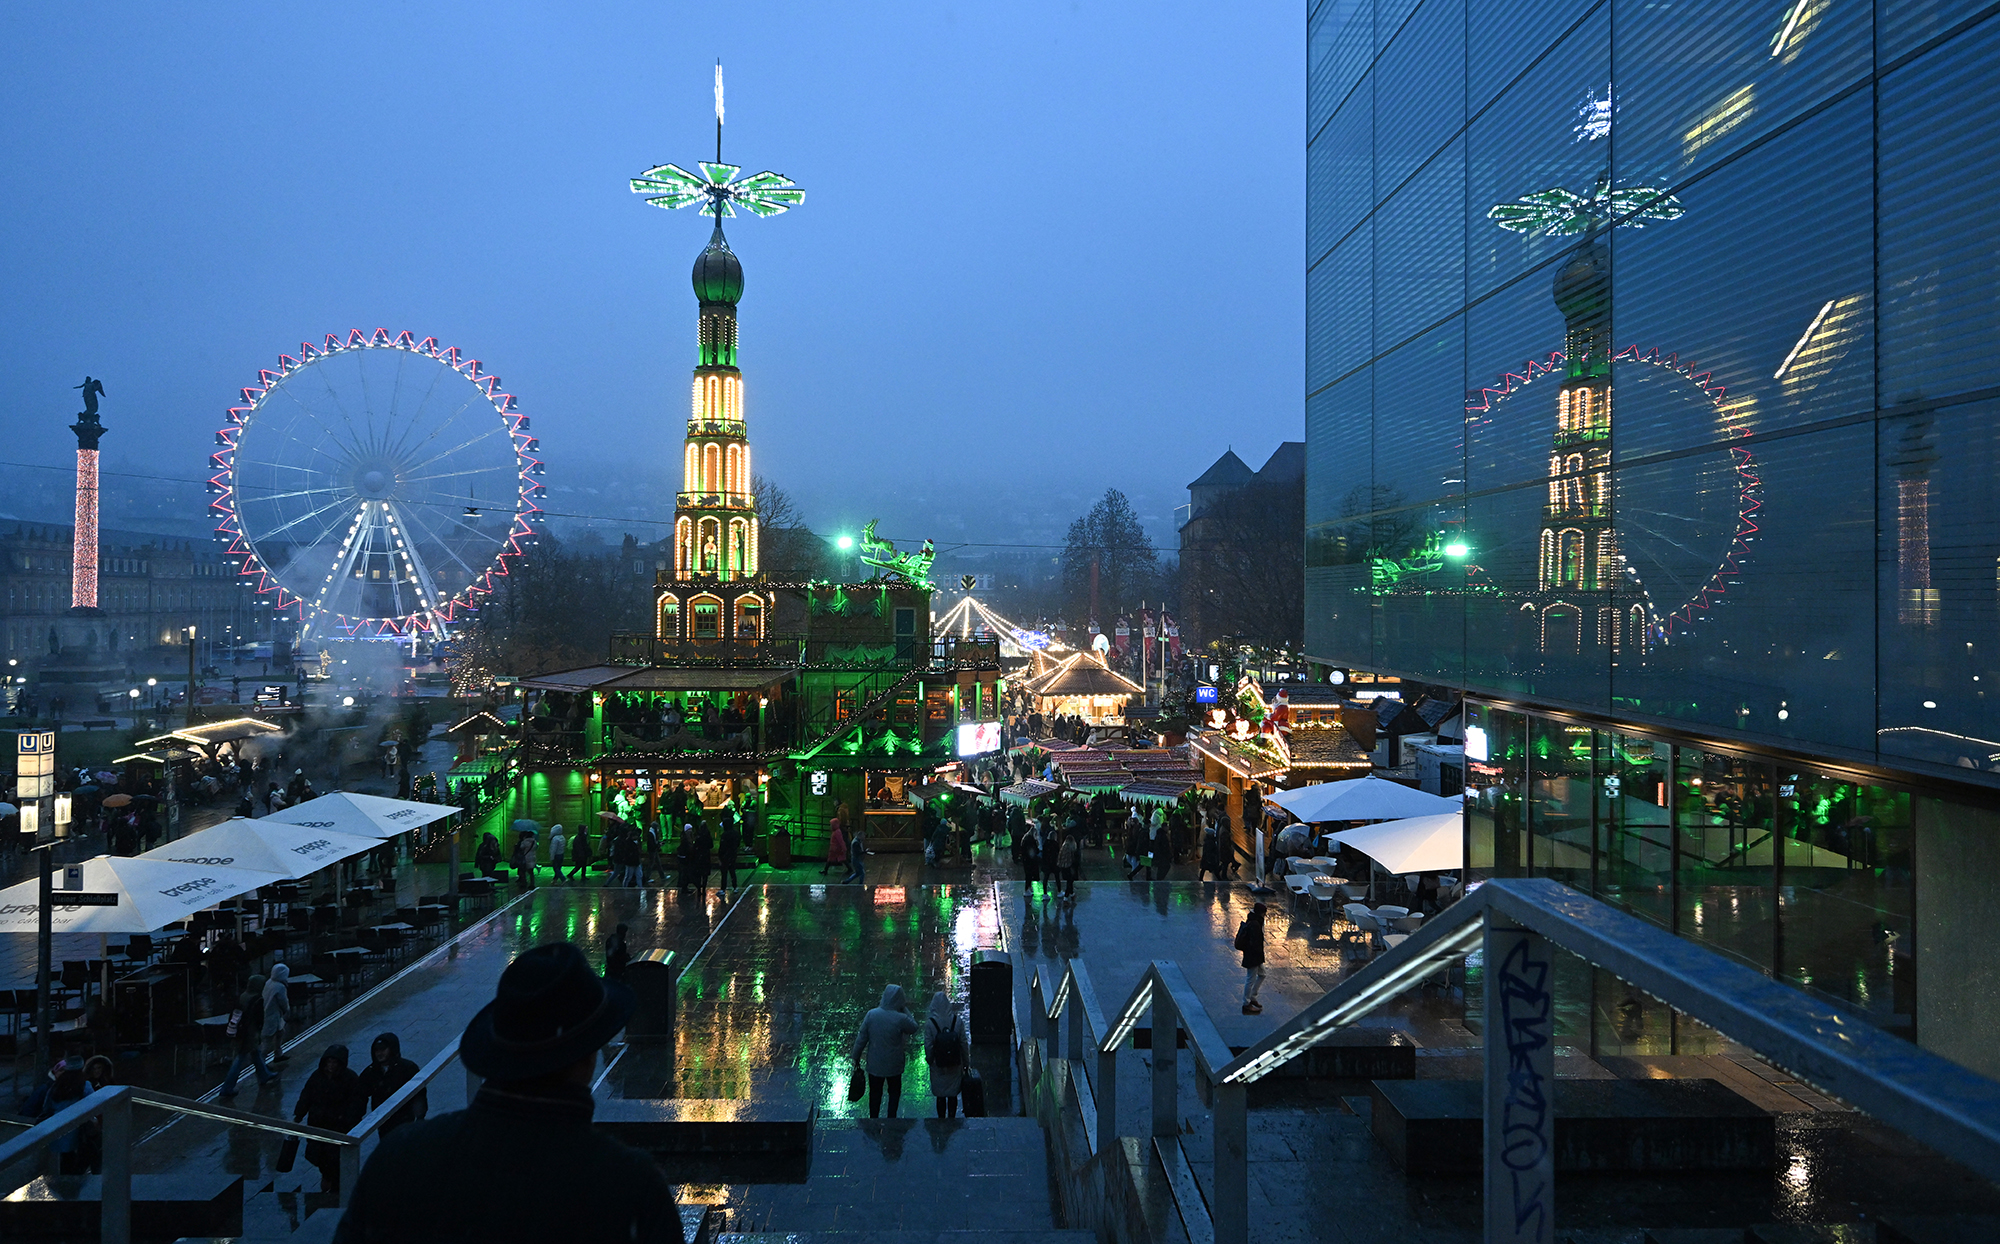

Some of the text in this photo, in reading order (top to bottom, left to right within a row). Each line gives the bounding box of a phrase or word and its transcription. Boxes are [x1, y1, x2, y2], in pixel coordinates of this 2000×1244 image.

[1198, 689, 1215, 698] WC
[23, 737, 35, 748] U
[44, 735, 51, 747] U
[291, 839, 331, 855] treppe
[159, 878, 216, 897] treppe
[53, 894, 76, 903] Kleiner
